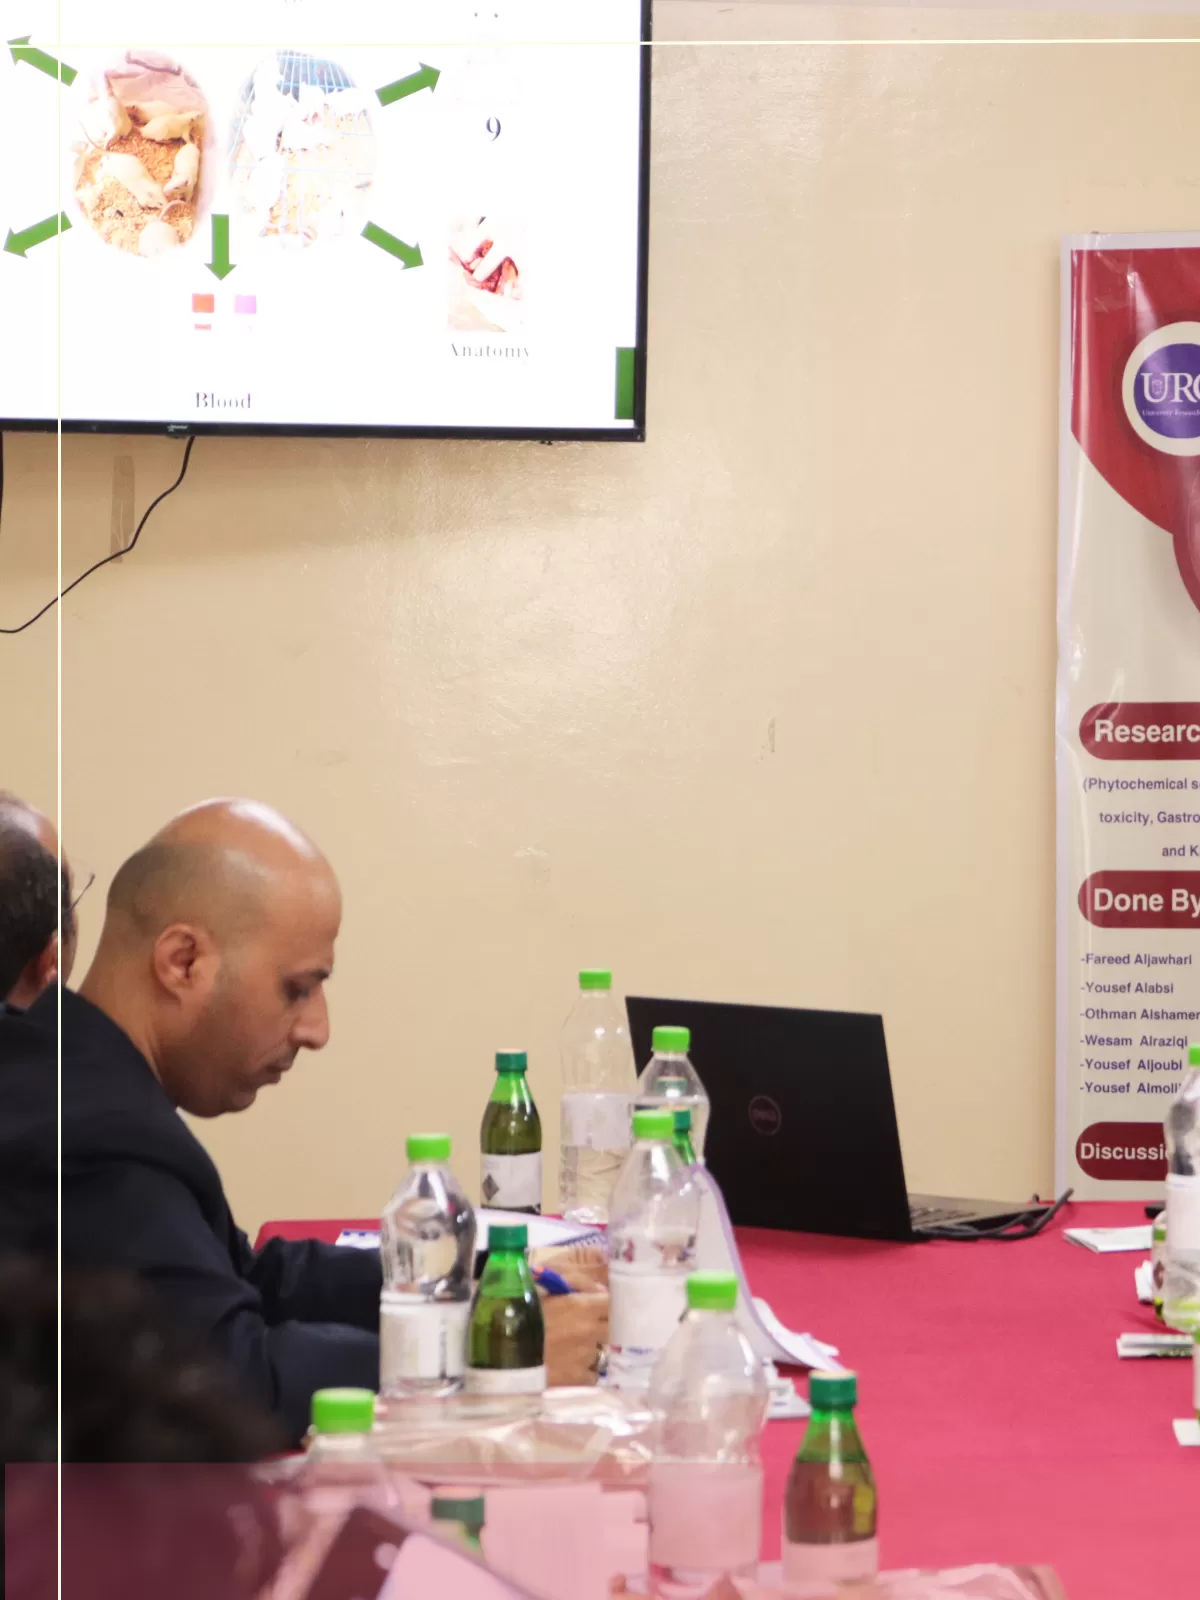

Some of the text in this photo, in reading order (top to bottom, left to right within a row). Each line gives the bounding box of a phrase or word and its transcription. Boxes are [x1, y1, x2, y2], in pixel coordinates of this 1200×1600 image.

[196, 392, 251, 409] Blood
[1083, 777, 1188, 792] (Phytochemical
[1099, 811, 1154, 827] toxicity,
[1162, 844, 1186, 857] and
[1094, 887, 1164, 912] Done
[1080, 953, 1193, 968] -Fareed Aljawhari
[1080, 981, 1174, 994] -Yousef Alabsi
[1079, 1008, 1137, 1020] -Othman
[1079, 1034, 1133, 1047] -Wesam
[1079, 1058, 1183, 1073] -Yousef Aljoubi
[1079, 1081, 1131, 1094] -Yousef
[1080, 1142, 1168, 1160] Discussi
